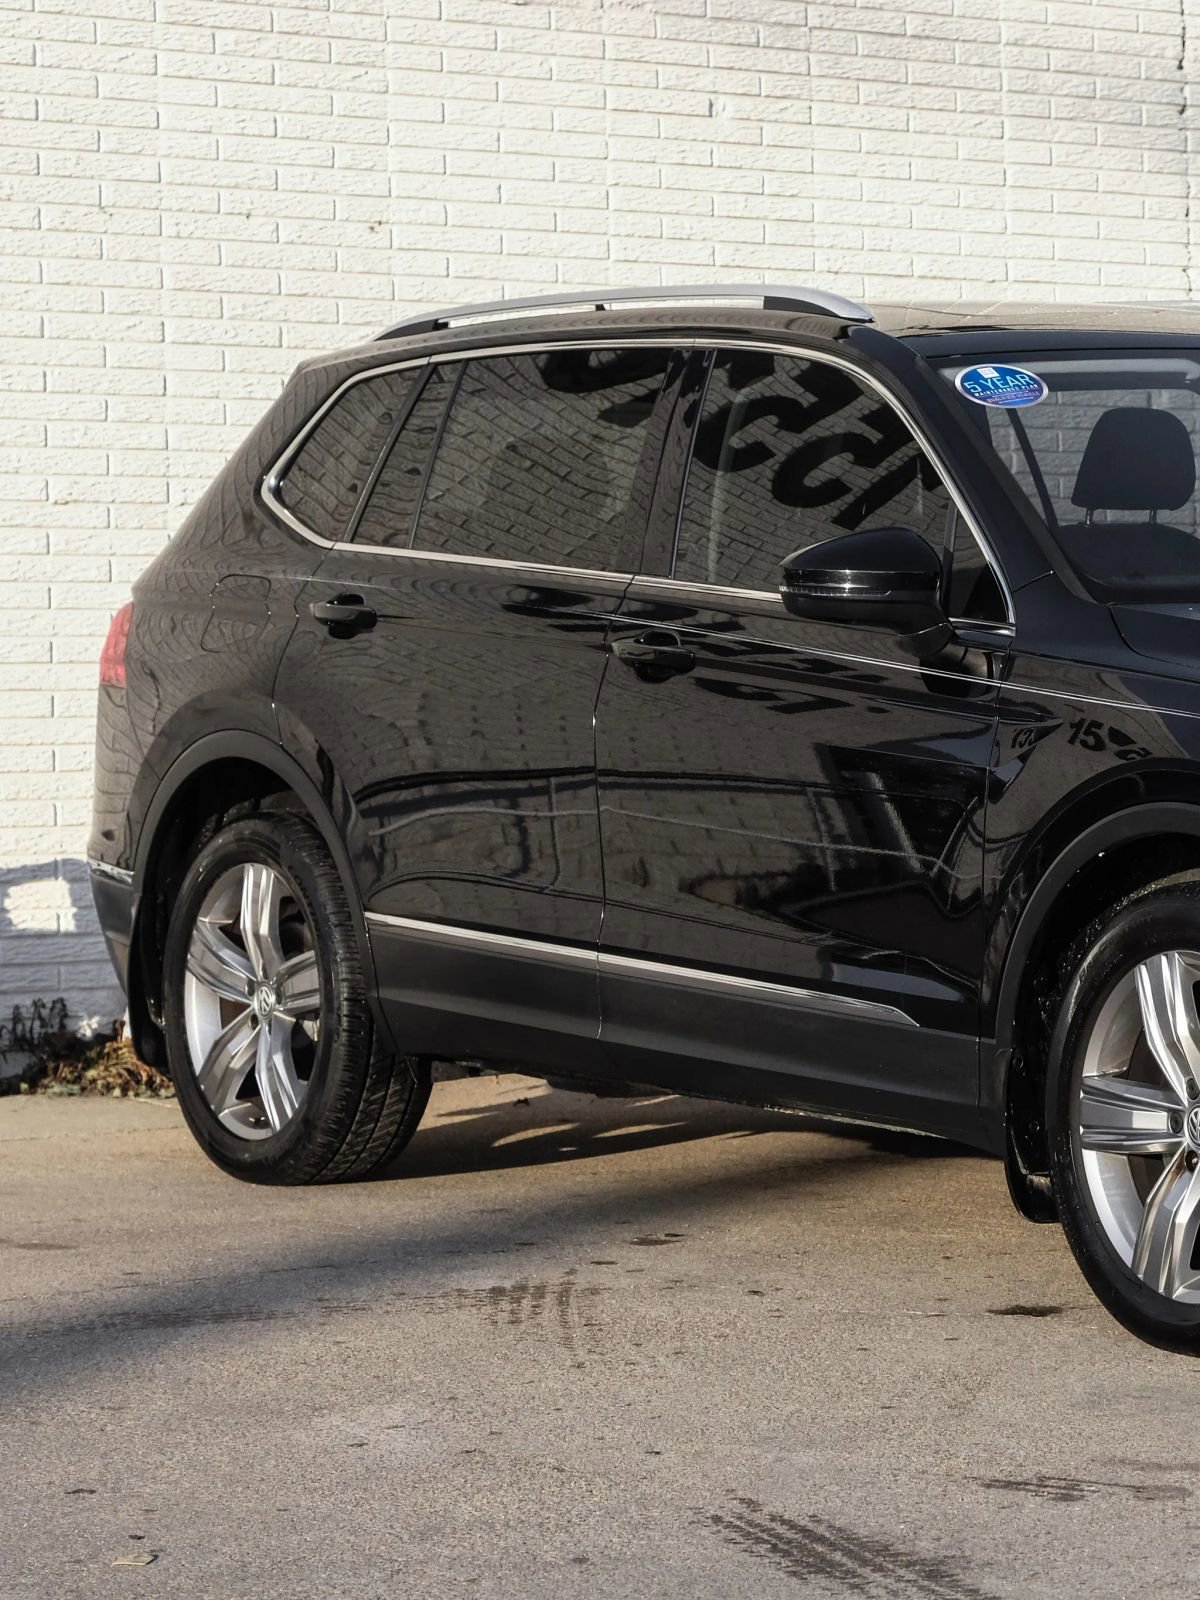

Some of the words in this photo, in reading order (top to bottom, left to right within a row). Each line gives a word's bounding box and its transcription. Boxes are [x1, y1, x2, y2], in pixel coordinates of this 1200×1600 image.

[963, 381, 982, 393] 5
[979, 374, 1034, 390] YEAR
[974, 386, 1019, 397] MAINTENANCE
